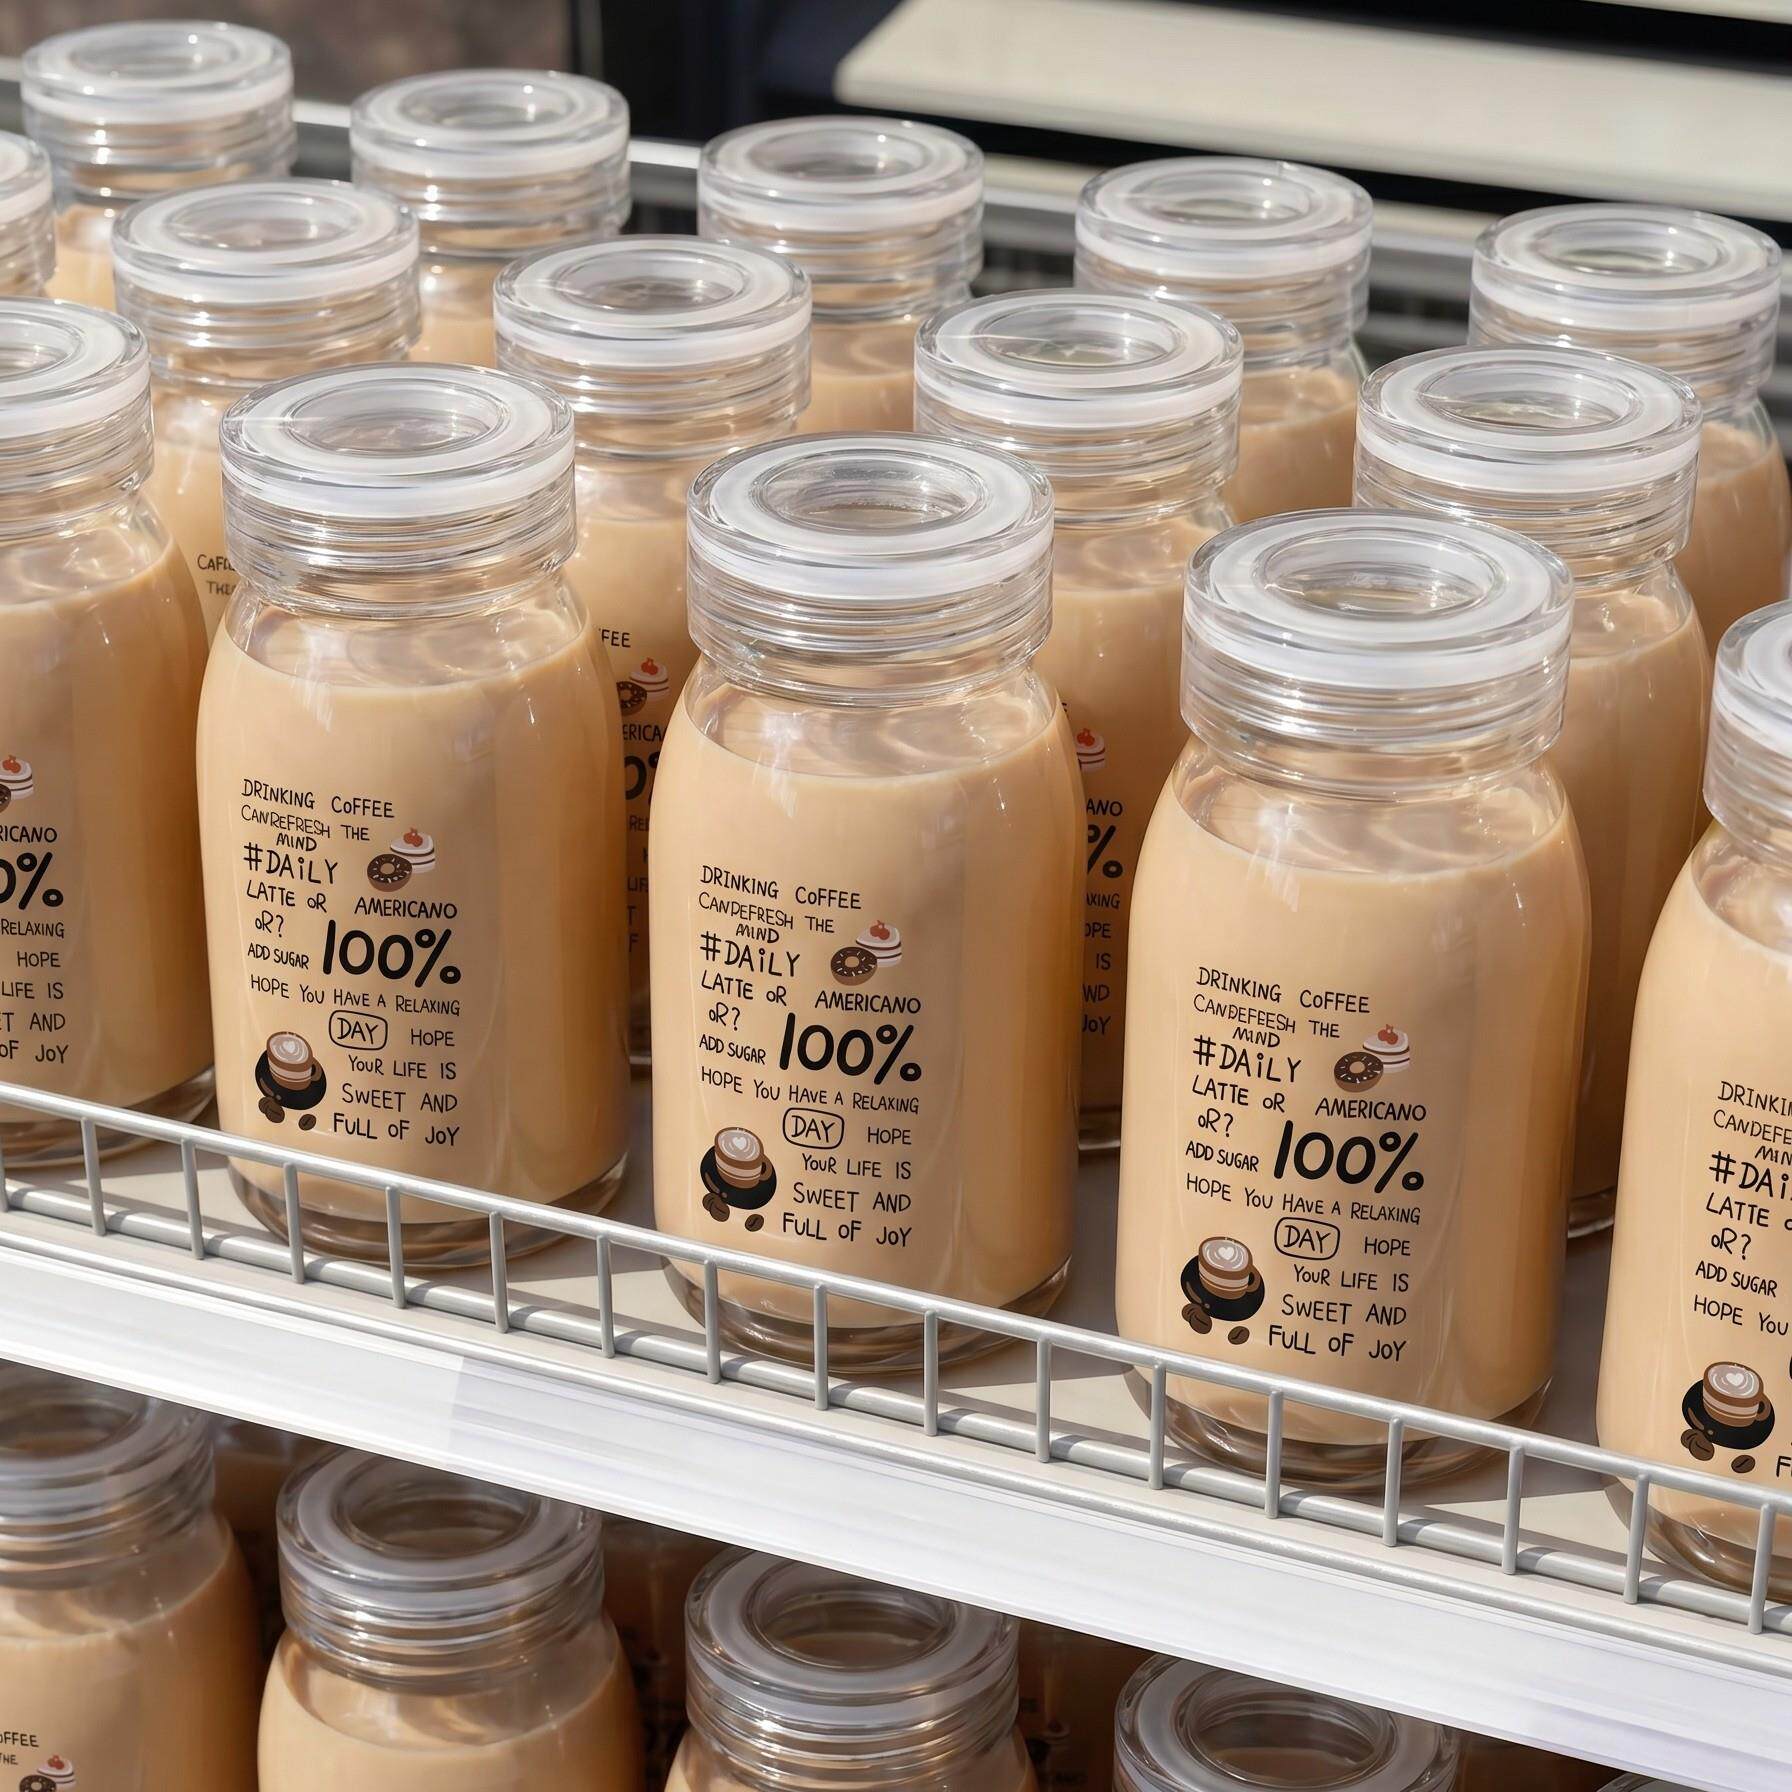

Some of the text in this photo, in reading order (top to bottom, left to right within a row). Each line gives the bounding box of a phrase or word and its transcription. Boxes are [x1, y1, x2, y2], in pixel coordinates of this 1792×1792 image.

[241, 779, 315, 810] DRINKING
[276, 832, 317, 852] MIND
[340, 824, 370, 841] THE
[700, 865, 779, 899] DRINKING
[247, 880, 295, 907] LATTE
[354, 896, 457, 919] AMERICANO
[736, 923, 779, 944] MIND
[804, 916, 835, 933] THE
[248, 942, 309, 970] ADD SUGAR
[323, 920, 461, 988] 100%
[2, 981, 63, 999] LIFE IS
[251, 974, 289, 999] HOPE
[377, 994, 386, 1008] A
[396, 995, 460, 1016] RELAXING
[701, 970, 753, 1000] LATTE
[815, 990, 921, 1014] AMERICANO
[1196, 967, 1282, 1003] DRINKING
[29, 1012, 65, 1032] AND
[337, 1017, 379, 1045] DAY
[1308, 1020, 1340, 1038] THE
[699, 1034, 766, 1065] ADD SUGAR
[779, 1012, 922, 1085] 100%
[1232, 1027, 1280, 1048] MIND
[393, 1060, 427, 1079] LIFE
[441, 1062, 456, 1080] IS
[420, 1092, 457, 1114] AND
[702, 1066, 743, 1094] HOPE
[834, 1091, 843, 1105] A
[853, 1092, 919, 1115] RELAXING
[1192, 1075, 1248, 1106] LATTE
[1315, 1097, 1426, 1121] AMERICANO
[791, 1115, 911, 1145] DAY HOPE
[847, 1159, 882, 1178] LIFE
[896, 1161, 911, 1180] IS
[1186, 1140, 1259, 1172] ADD SUGAR
[1274, 1120, 1424, 1194] 100%
[872, 1192, 911, 1214] AND
[1187, 1173, 1231, 1202] HOPE
[1331, 1201, 1341, 1215] A
[1351, 1202, 1420, 1225] RELAXING
[1706, 1192, 1770, 1227] LATTE
[1283, 1225, 1411, 1256] DAY HOPE
[1341, 1271, 1378, 1291] LIFE
[1393, 1273, 1409, 1292] IS
[1695, 1260, 1777, 1298] ADD SUGAR
[1365, 1303, 1406, 1326] AND
